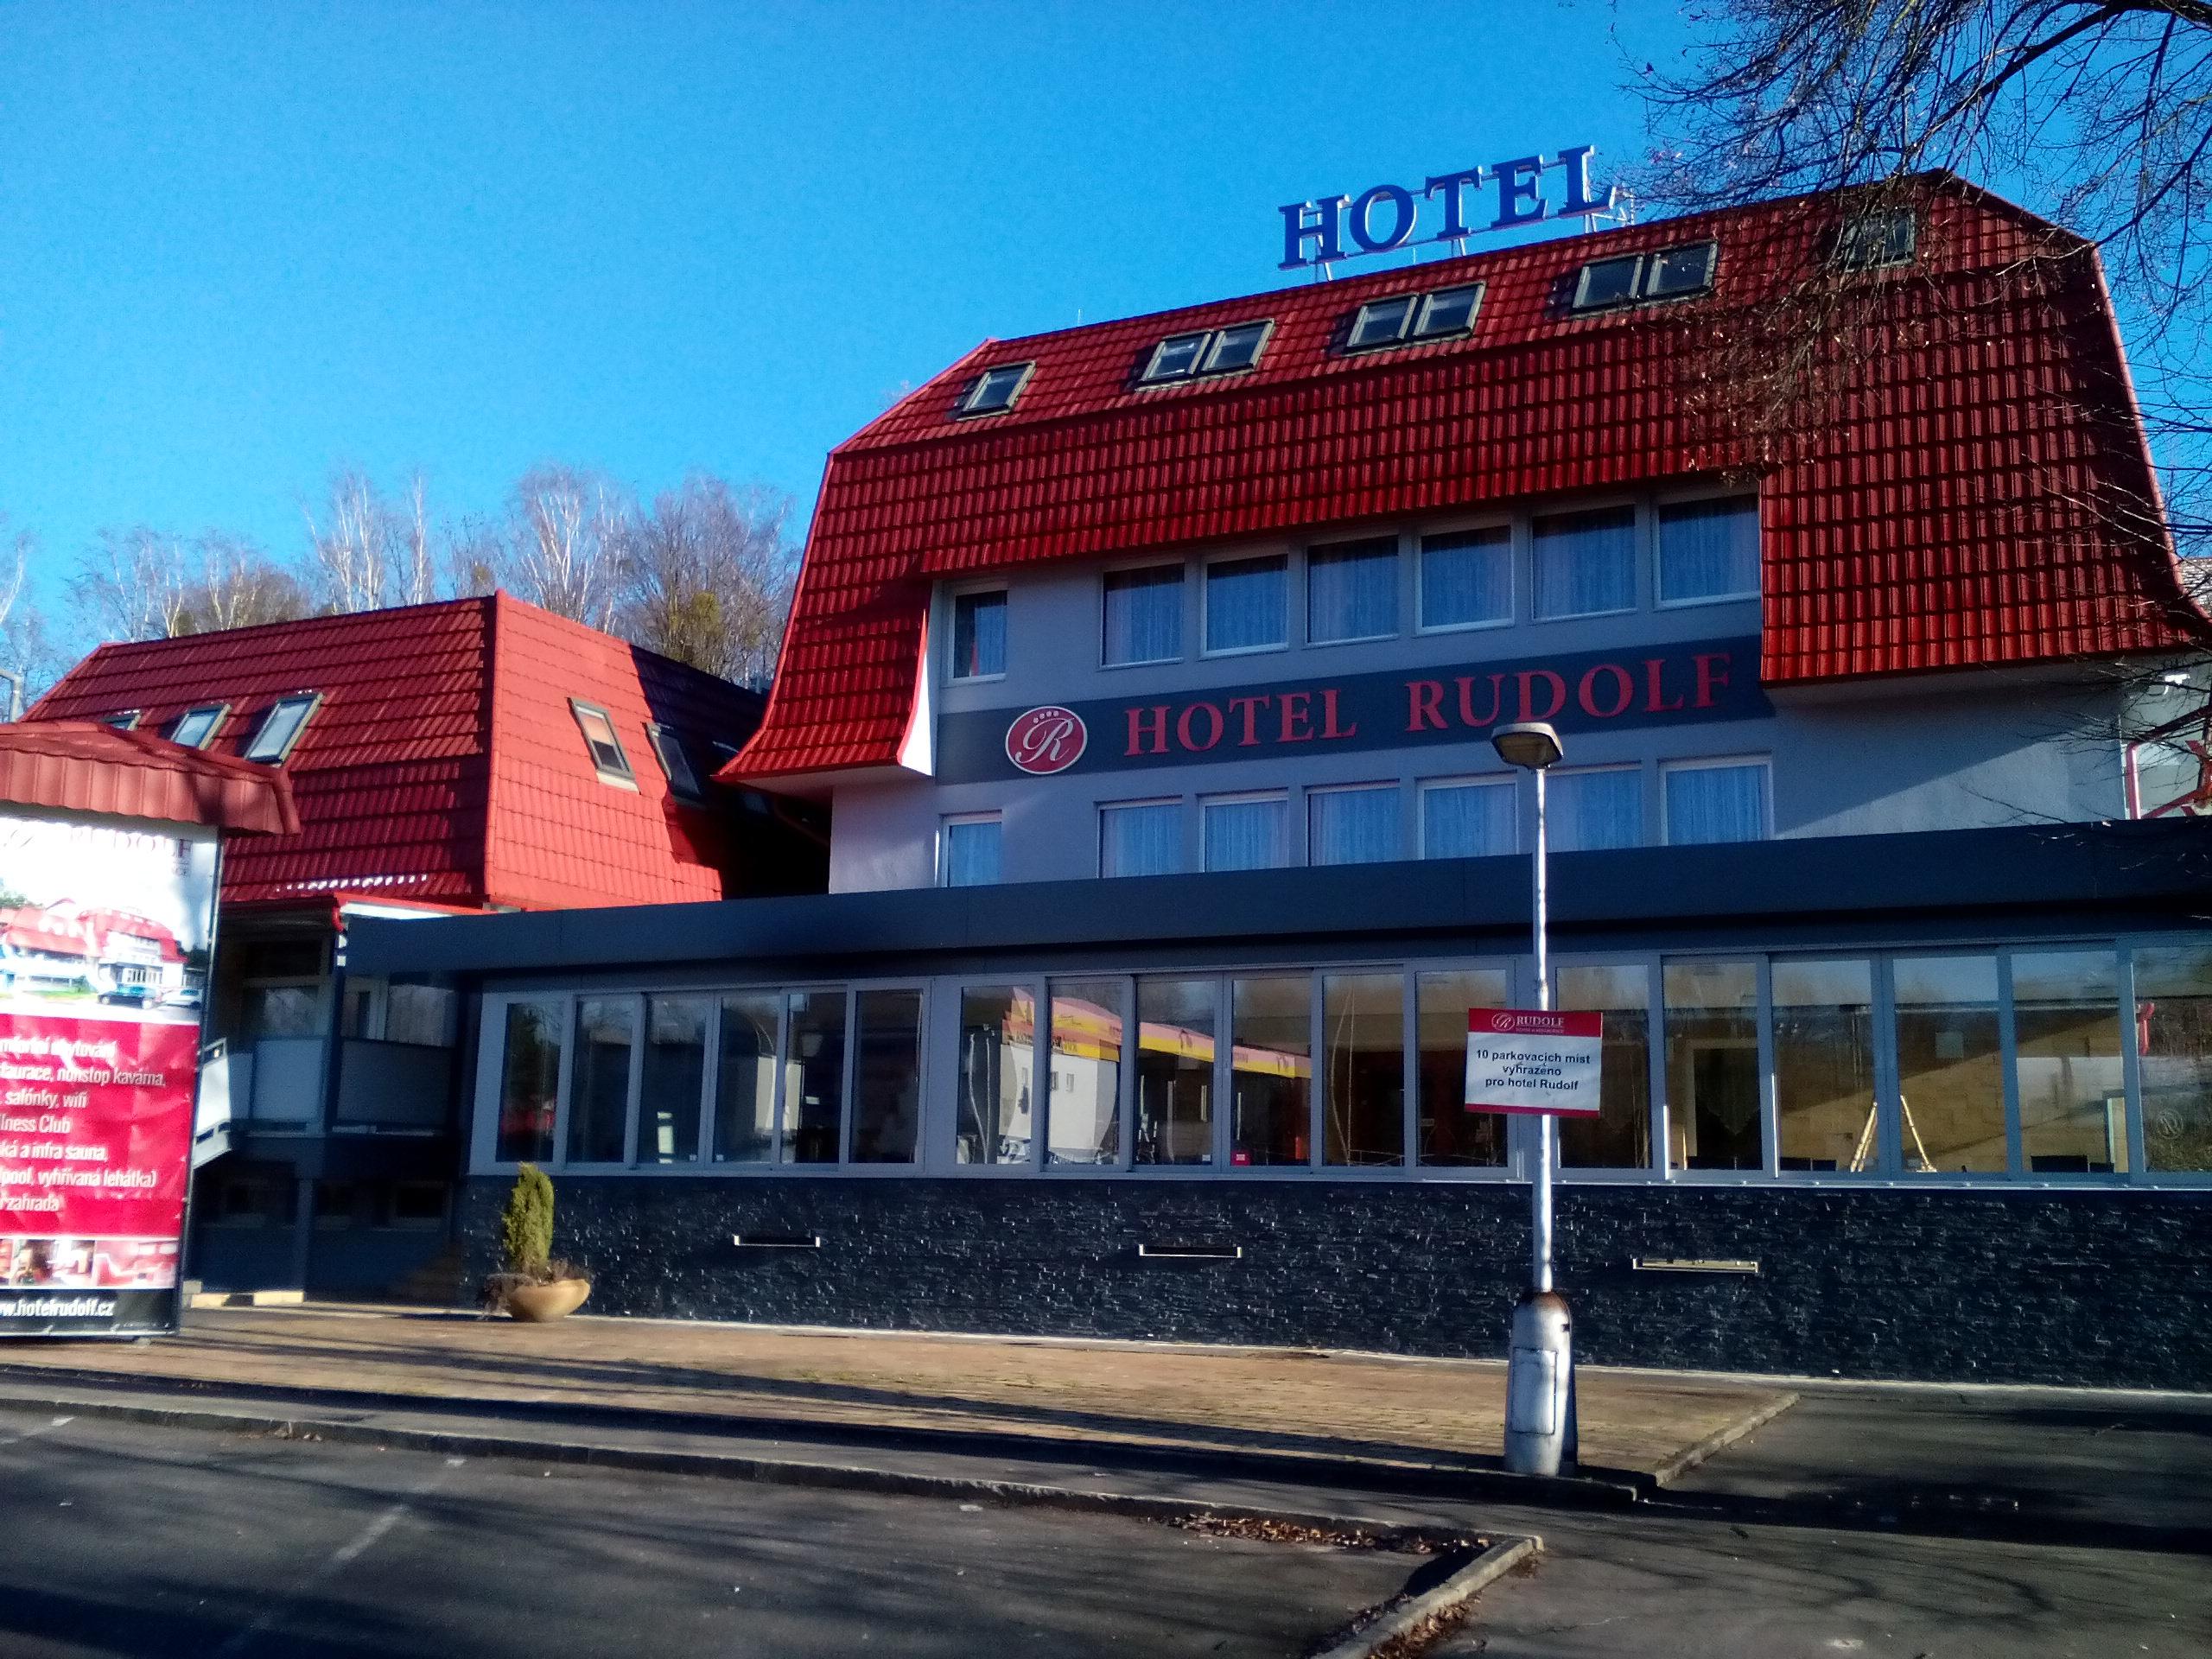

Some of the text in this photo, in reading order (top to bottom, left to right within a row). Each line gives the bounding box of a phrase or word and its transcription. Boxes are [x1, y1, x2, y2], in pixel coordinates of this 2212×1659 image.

[1278, 144, 1616, 270] HOTEL
[1124, 652, 1732, 757] HOTEL RUDOLF
[1516, 1015, 1564, 1027] RUDOLF
[1477, 1049, 1591, 1065] 10 parkovacích míst
[0, 1062, 54, 1082] taurace,
[57, 1065, 111, 1085] nonstop
[1502, 1065, 1561, 1077] vyhrazeno
[1485, 1077, 1579, 1090] pro hotel Rudolf
[0, 1113, 71, 1134] lness Club
[20, 1144, 31, 1159] a
[32, 1141, 63, 1160] infra
[103, 1168, 158, 1188] lehátka)
[7, 1192, 60, 1211] zahrada
